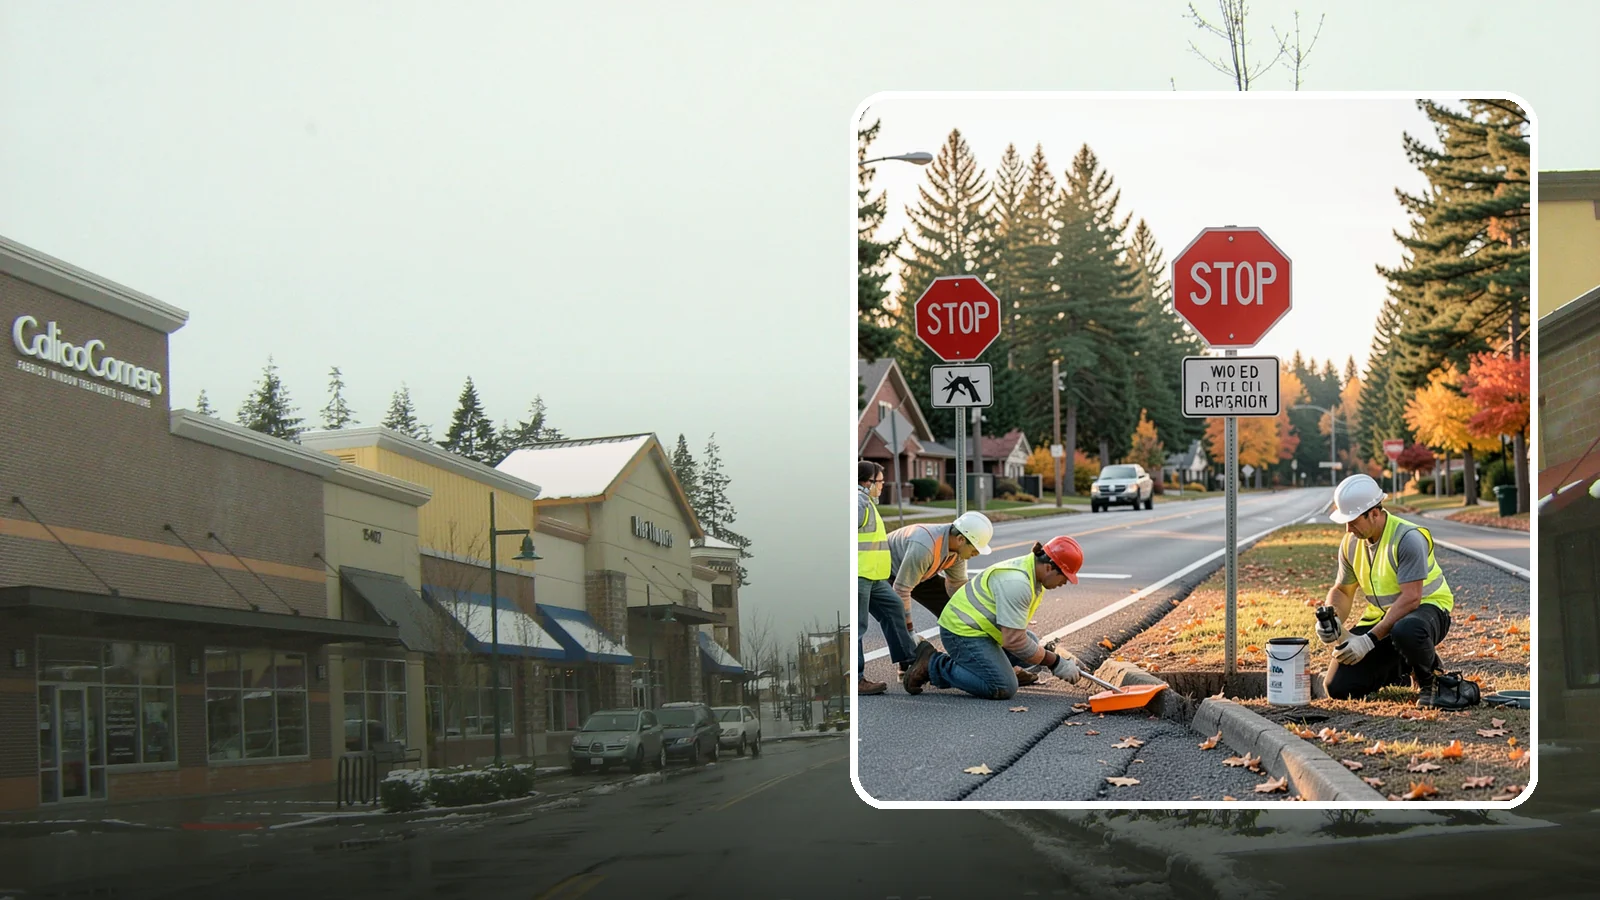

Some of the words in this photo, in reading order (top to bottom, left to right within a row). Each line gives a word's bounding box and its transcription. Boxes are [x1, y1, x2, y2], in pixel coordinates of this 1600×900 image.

[1190, 260, 1277, 306] STOP
[927, 301, 990, 335] STOP
[16, 360, 47, 377] FABRICS
[51, 370, 78, 386] WINDOW
[79, 379, 116, 398] TREATMENTS
